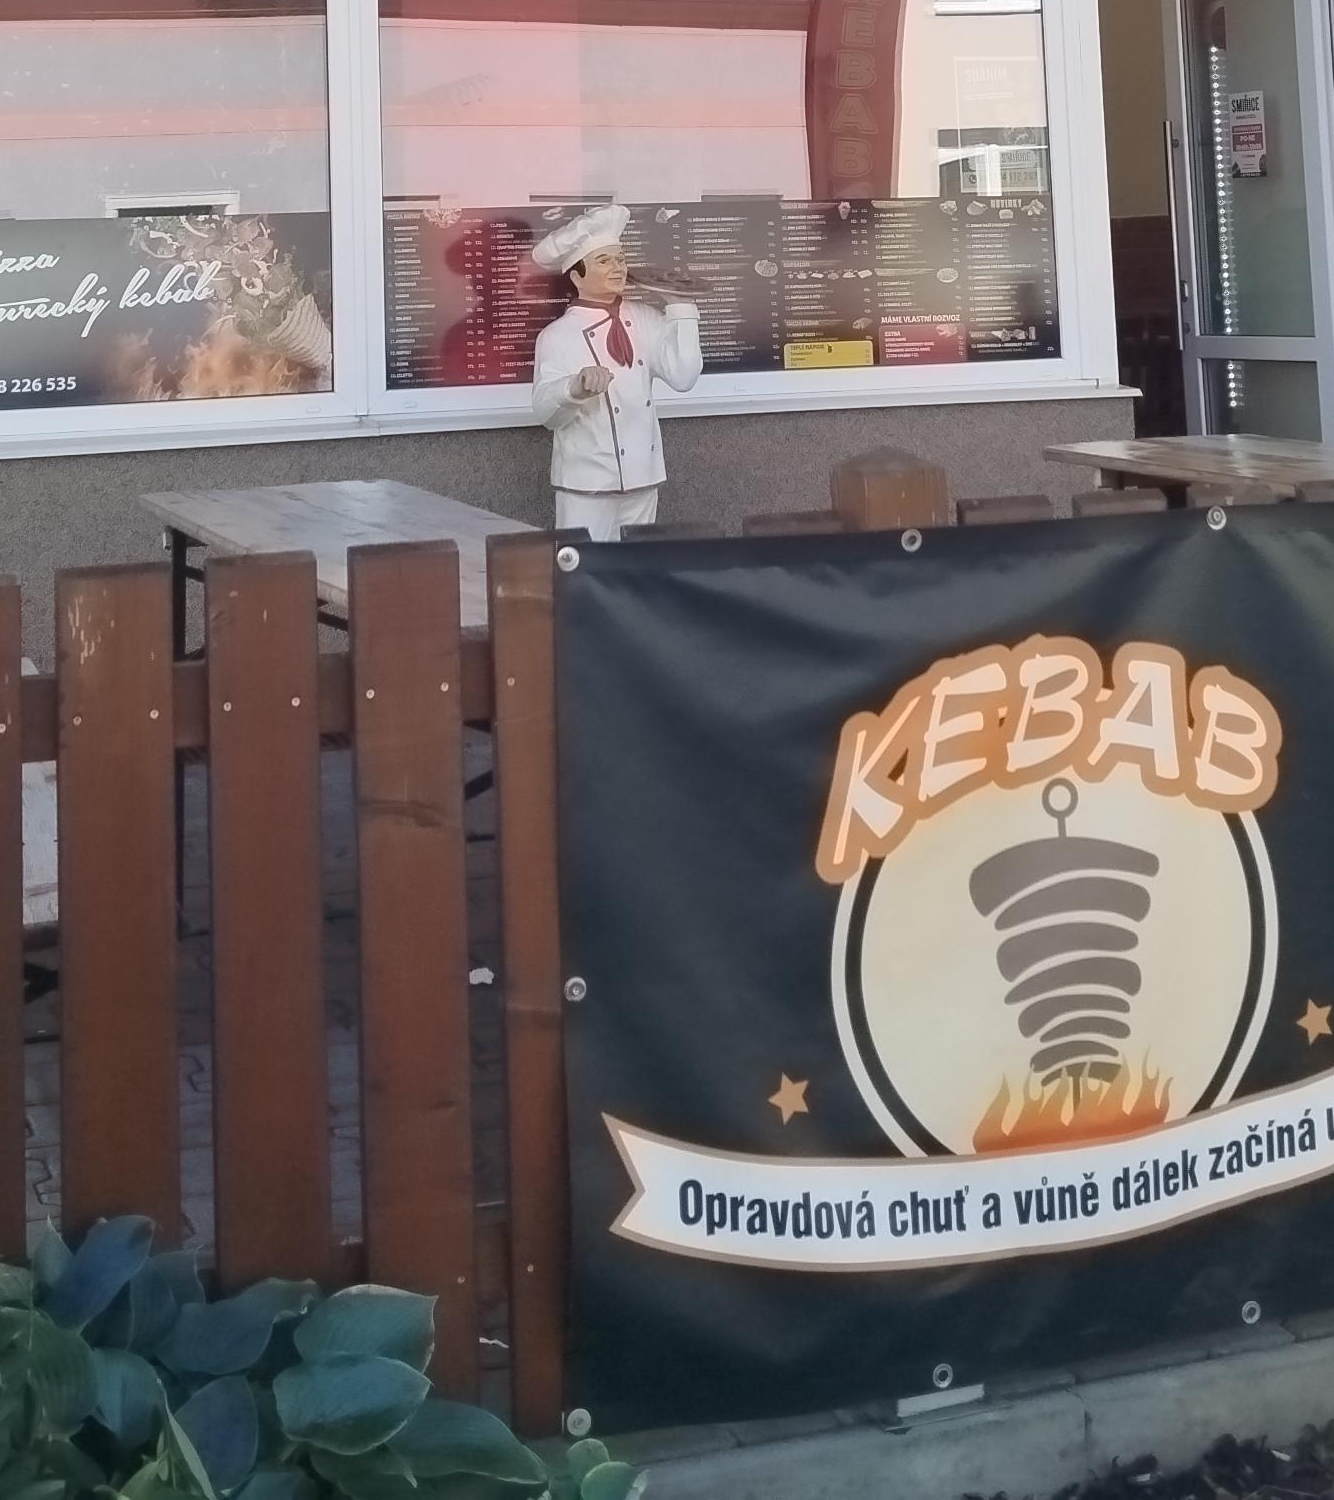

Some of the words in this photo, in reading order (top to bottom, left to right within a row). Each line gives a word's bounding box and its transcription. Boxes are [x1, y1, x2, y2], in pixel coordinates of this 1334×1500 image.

[119, 260, 222, 309] kebab
[11, 377, 43, 394] 226
[46, 376, 77, 392] 535
[825, 648, 1275, 868] KEBAB
[678, 1179, 876, 1241] Opravdová
[888, 1184, 972, 1238] chuť
[982, 1195, 1002, 1229] a
[1013, 1170, 1102, 1227] vůně
[1111, 1147, 1200, 1211] dálek
[1207, 1107, 1318, 1181] začíná
